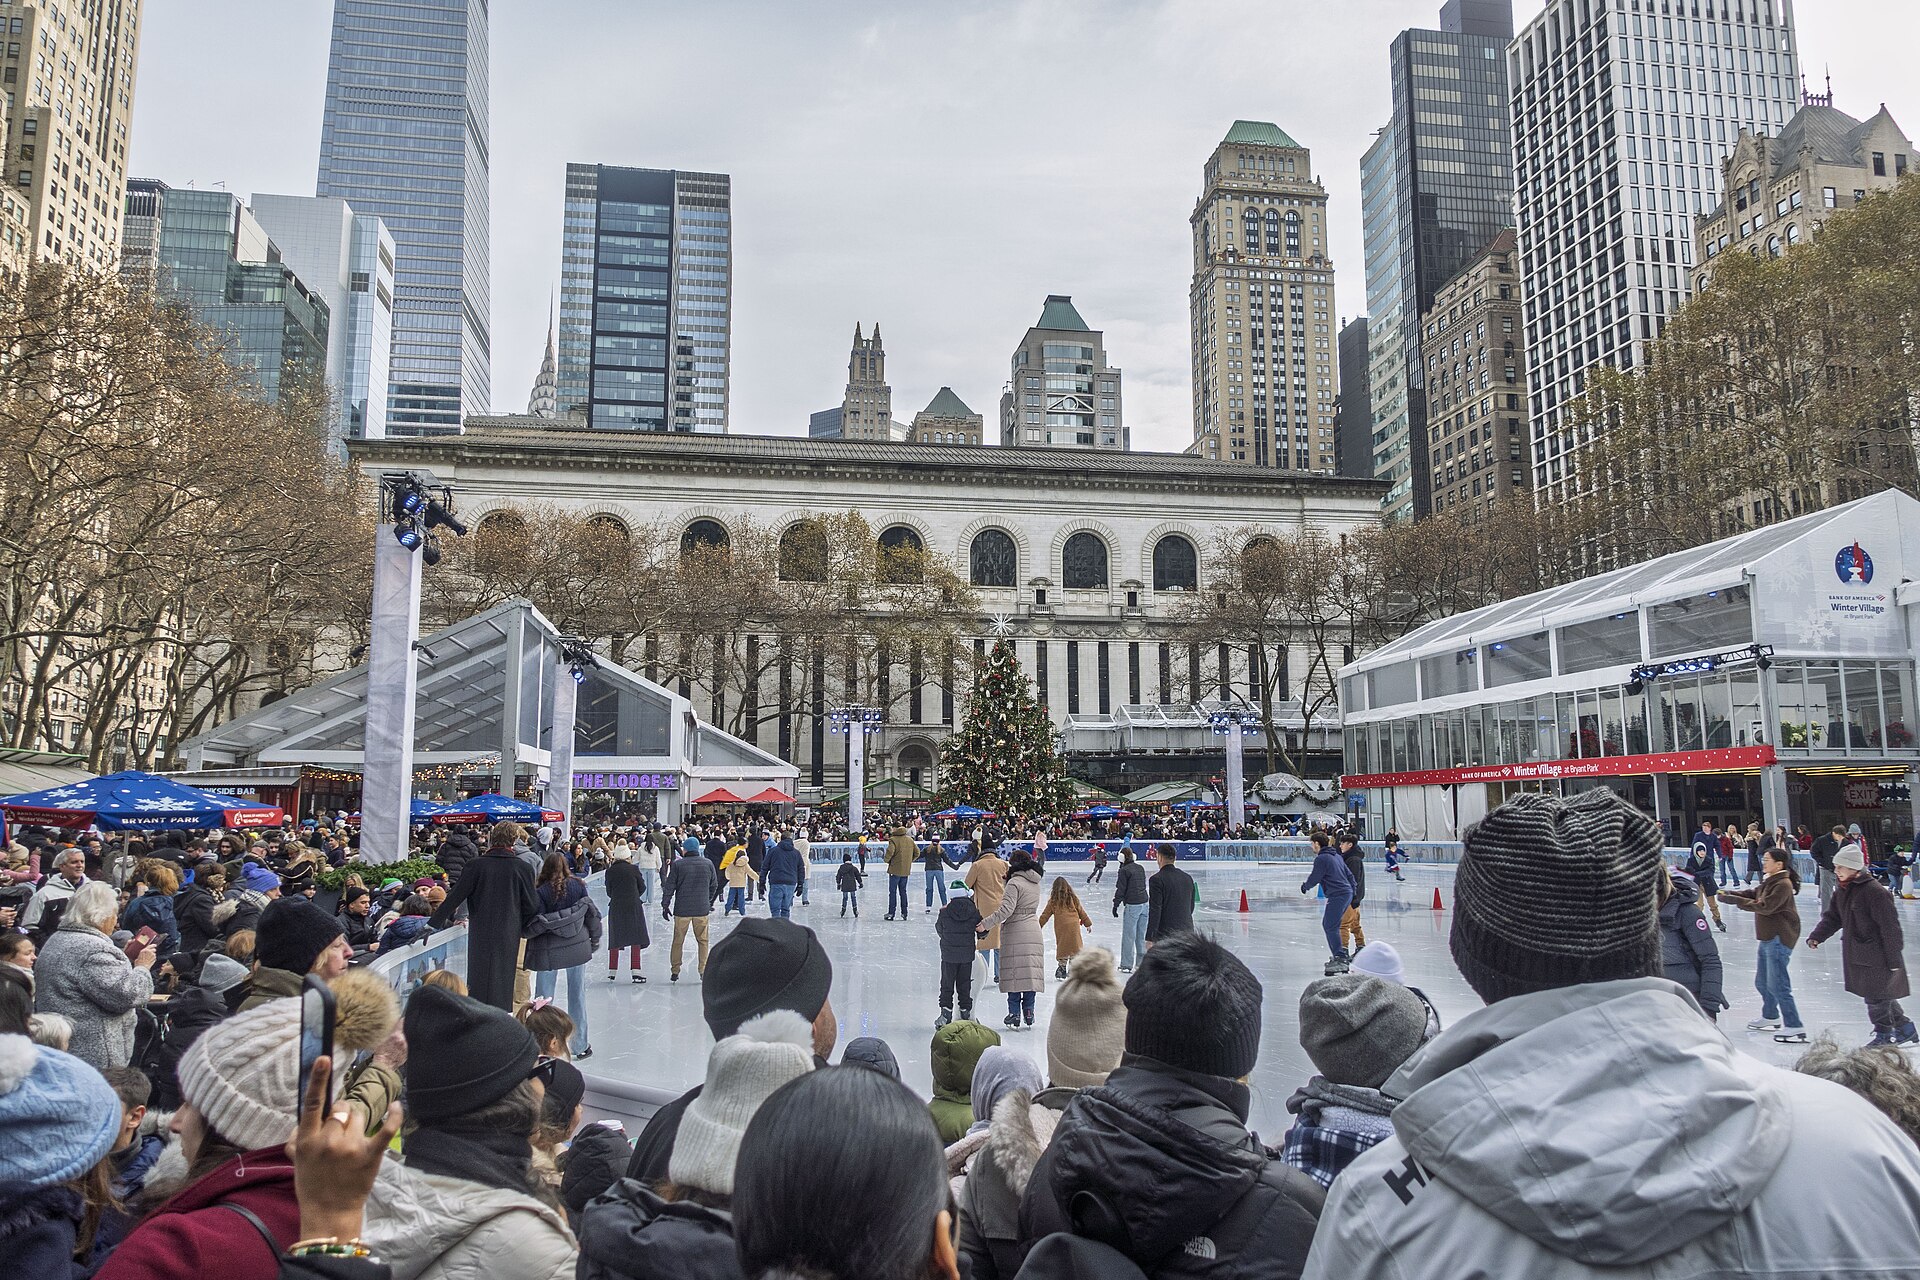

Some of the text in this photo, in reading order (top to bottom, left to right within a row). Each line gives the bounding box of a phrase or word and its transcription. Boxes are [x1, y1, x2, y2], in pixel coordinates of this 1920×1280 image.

[1831, 603, 1885, 614] Winter Village
[1480, 770, 1501, 778] AMERICA
[1513, 765, 1537, 777] Winter
[1537, 763, 1562, 776] Village
[1570, 764, 1587, 775] Bryant
[1587, 763, 1598, 773] Park
[573, 774, 660, 788] THE LODGE
[237, 787, 255, 795] BAR
[1786, 784, 1800, 792] XIT
[1849, 789, 1873, 800] EXIT
[1054, 846, 1072, 854] magic
[1382, 1154, 1436, 1206] H
